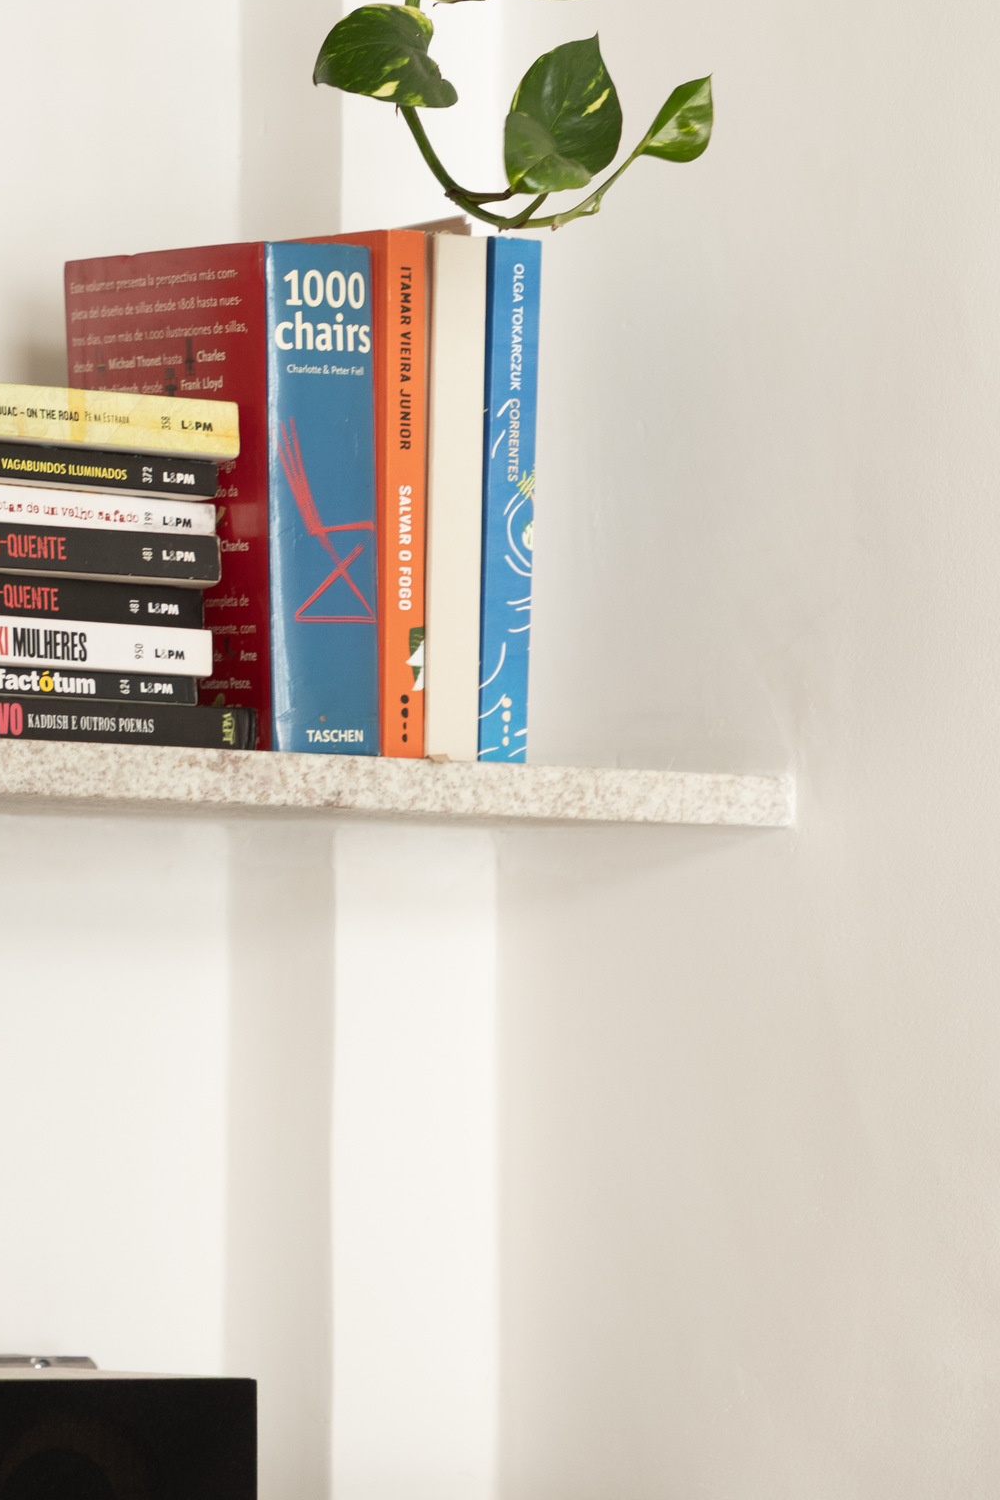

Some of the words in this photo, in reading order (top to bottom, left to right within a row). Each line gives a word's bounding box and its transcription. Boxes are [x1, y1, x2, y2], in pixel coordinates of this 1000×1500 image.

[282, 269, 366, 310] 1000
[512, 262, 525, 303] OLGA
[399, 266, 412, 326] ITAMAR
[274, 311, 371, 354] chairs
[196, 349, 226, 363] Charles
[399, 331, 412, 383] VIEIRA
[509, 307, 524, 391] TOKARCZUK
[286, 363, 322, 375] Charlotte
[331, 365, 350, 376] Peter
[350, 366, 364, 376] Fiell
[180, 378, 202, 392] Frank
[202, 375, 224, 392] Lloyd
[58, 410, 80, 422] ROAD
[161, 416, 171, 430] 358
[399, 388, 412, 450] JUNIOR
[181, 420, 213, 432] L&PM
[506, 398, 521, 483] CORRENTES
[1, 457, 66, 475] VAGABUNDOS
[68, 463, 128, 481] ILUMINADOS
[142, 466, 153, 484] 372
[162, 471, 196, 485] L&PM
[144, 512, 153, 525] 199
[162, 516, 192, 528] L&PM
[398, 484, 412, 545] SALVAR
[221, 539, 250, 553] Charles
[142, 547, 153, 562] 481
[161, 549, 196, 563] L&PM
[398, 566, 412, 611] FOGO
[129, 599, 140, 614] 481
[147, 602, 180, 616] L&PM
[12, 627, 88, 662] MULHERES
[134, 643, 144, 659] 950
[154, 649, 185, 660] L&PM
[120, 679, 130, 695] 624
[140, 682, 173, 695] L&PM
[27, 713, 69, 730] KADDISH
[80, 716, 117, 732] OUTROS
[118, 717, 155, 733] POEMAS
[305, 729, 364, 743] TASCHEN
